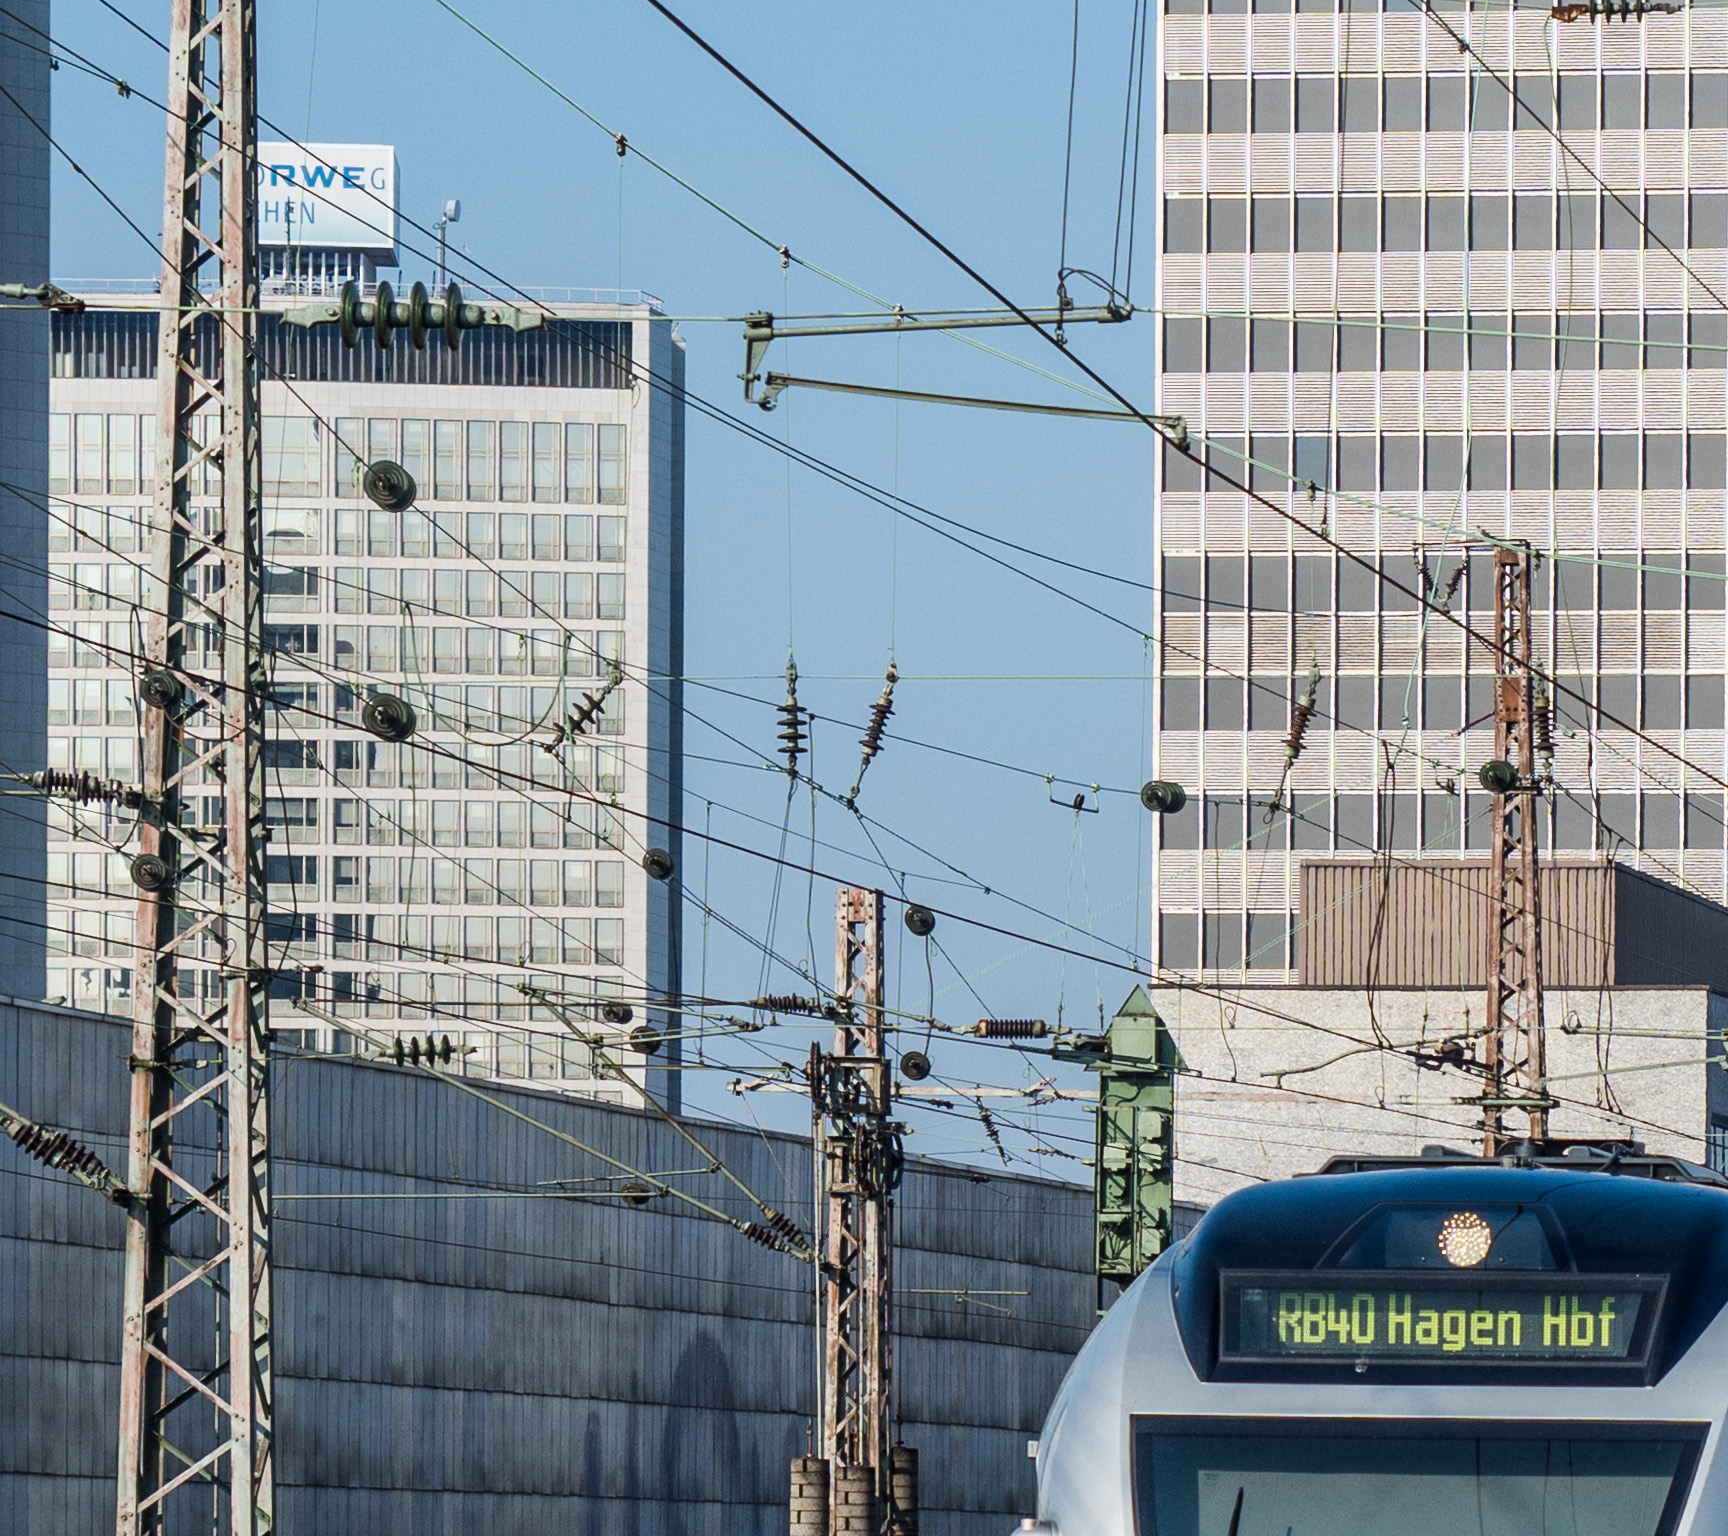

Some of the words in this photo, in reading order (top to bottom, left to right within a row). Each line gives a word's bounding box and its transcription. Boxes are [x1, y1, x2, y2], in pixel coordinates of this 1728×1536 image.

[257, 164, 386, 191] RWEG
[257, 200, 315, 224] HEN
[1278, 1293, 1375, 1344] RB40
[1388, 1294, 1521, 1351] Hagen
[1543, 1296, 1616, 1348] Hbf
